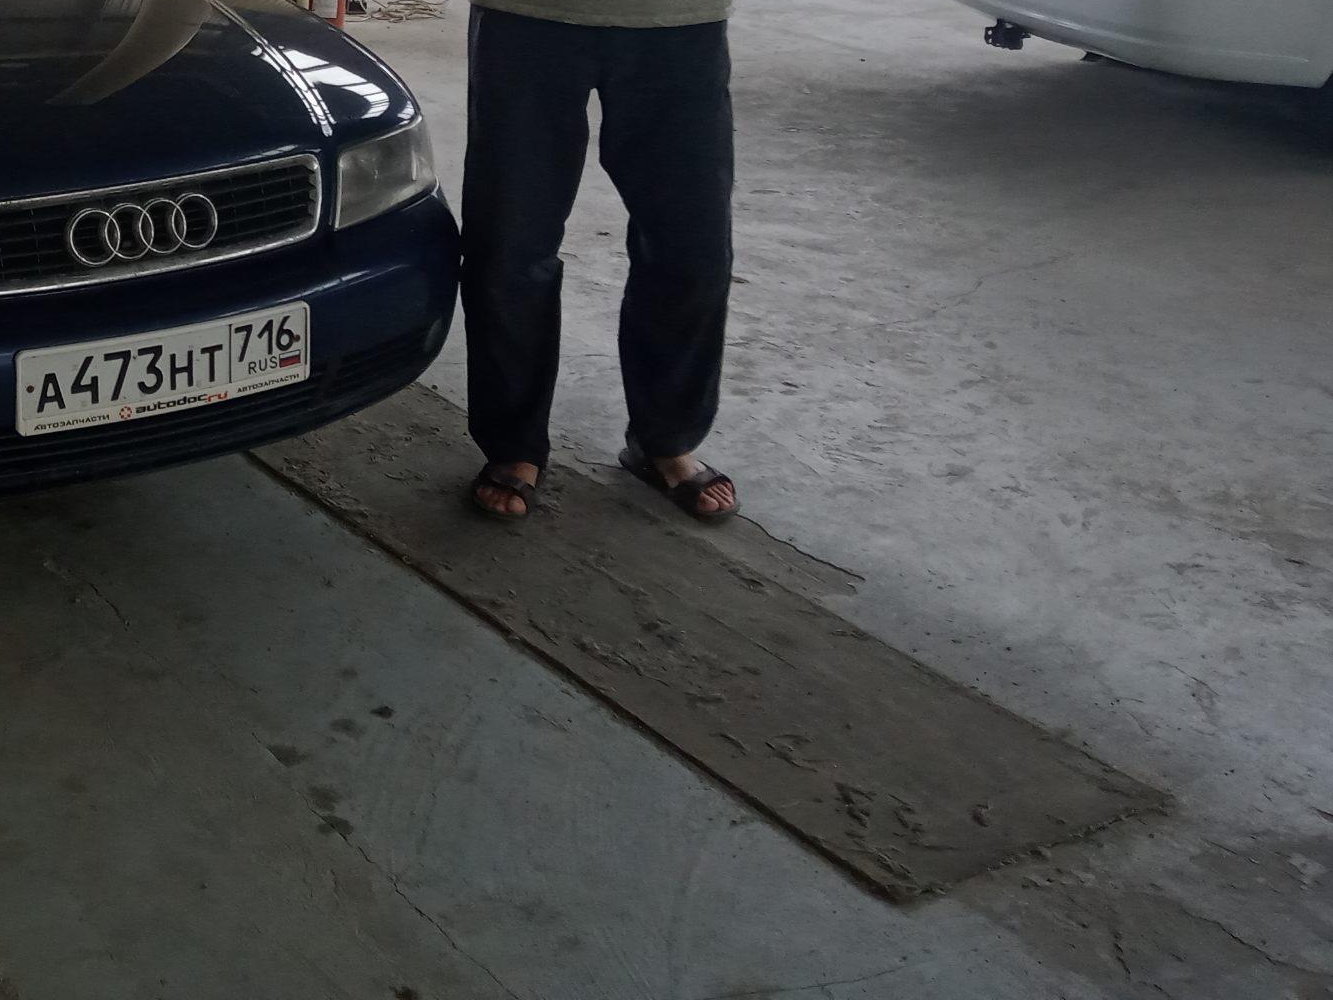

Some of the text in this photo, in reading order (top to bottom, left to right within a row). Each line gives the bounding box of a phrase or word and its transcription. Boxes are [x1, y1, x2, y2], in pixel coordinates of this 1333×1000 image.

[234, 315, 294, 362] 716
[247, 357, 279, 375] RUS
[34, 414, 110, 431] АВТОЗАПЧАСТИ
[237, 373, 300, 393] АВТОЗАПЧАСТИ
